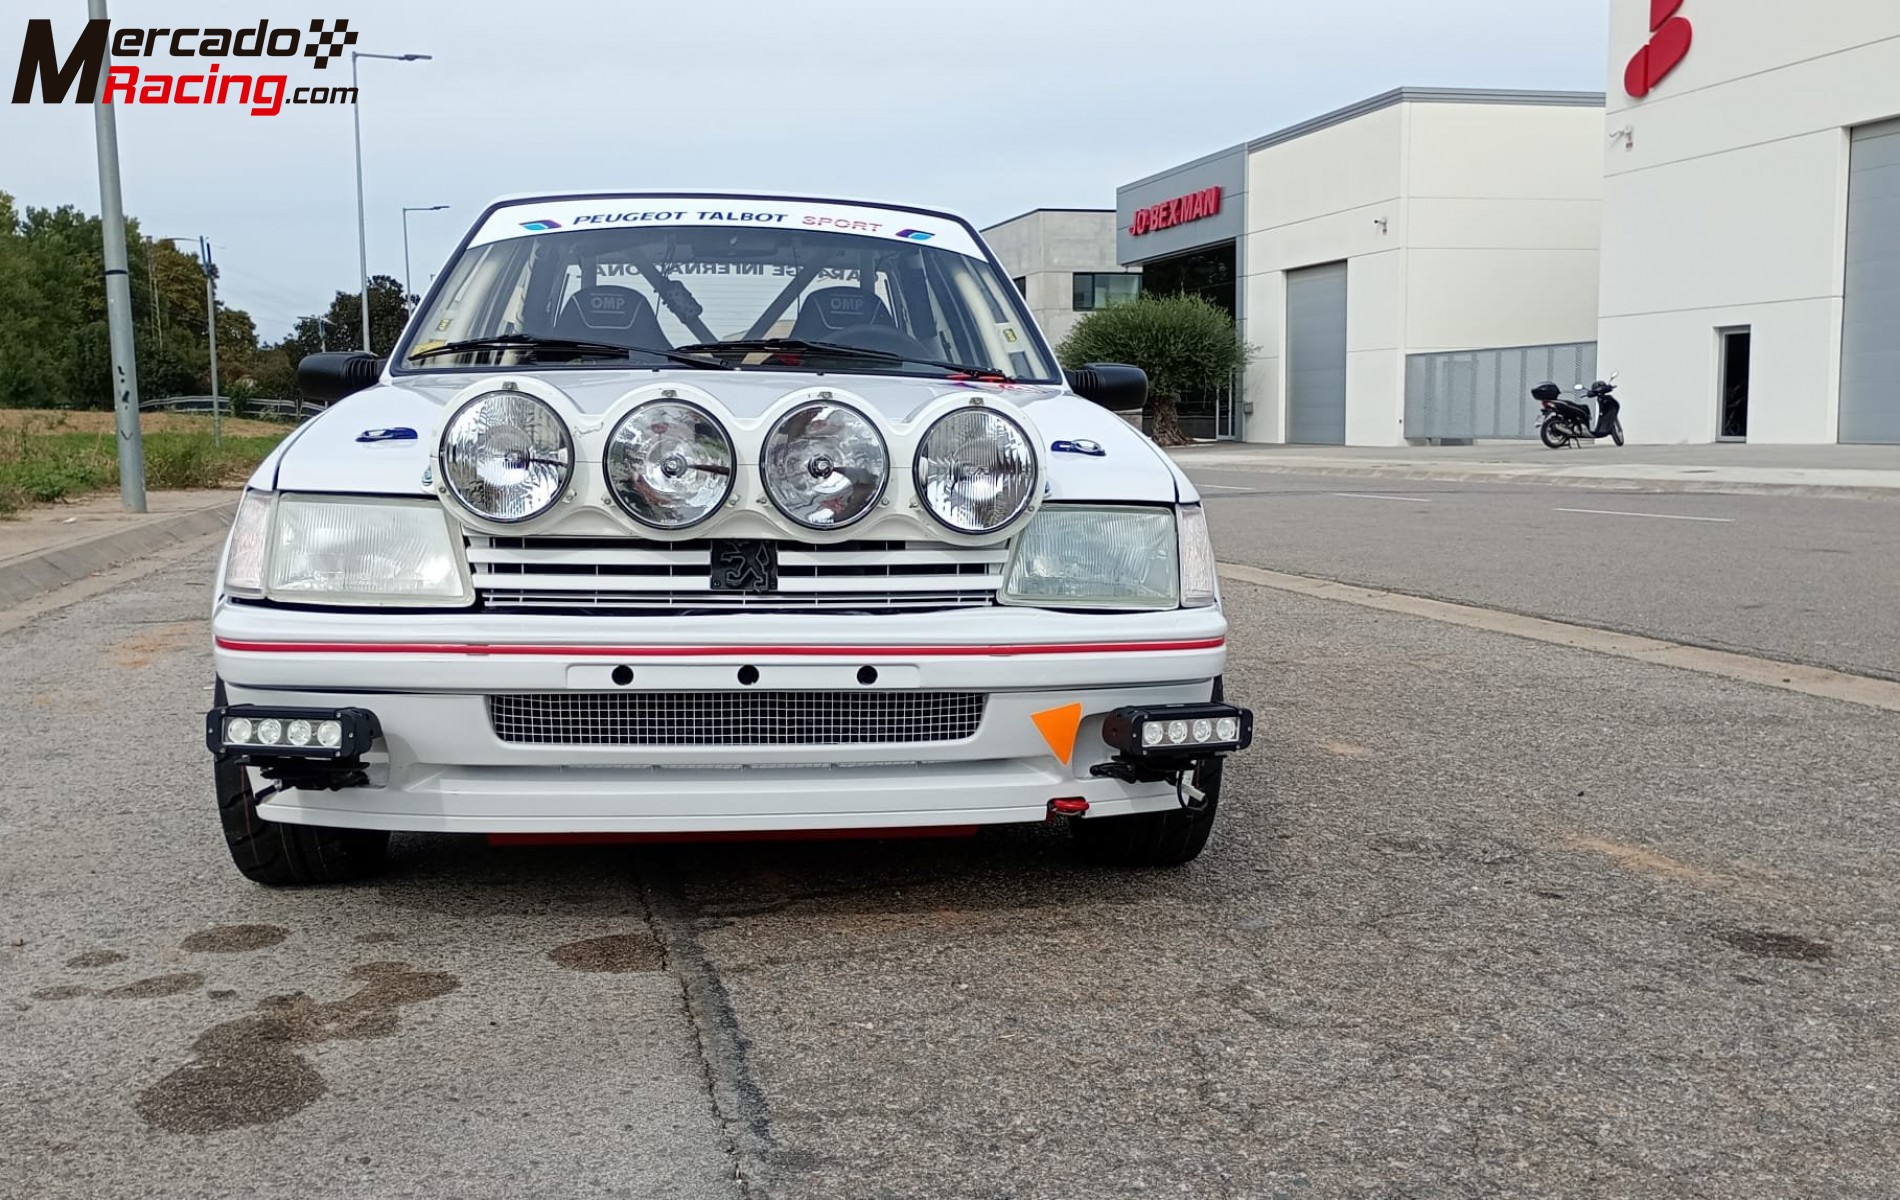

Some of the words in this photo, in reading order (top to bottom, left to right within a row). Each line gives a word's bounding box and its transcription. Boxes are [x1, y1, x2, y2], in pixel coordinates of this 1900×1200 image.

[572, 211, 687, 225] PEUGEOT
[697, 211, 788, 222] TALBOT
[802, 215, 883, 231] SPORT
[590, 297, 625, 310] OMP
[831, 298, 864, 310] OMP
